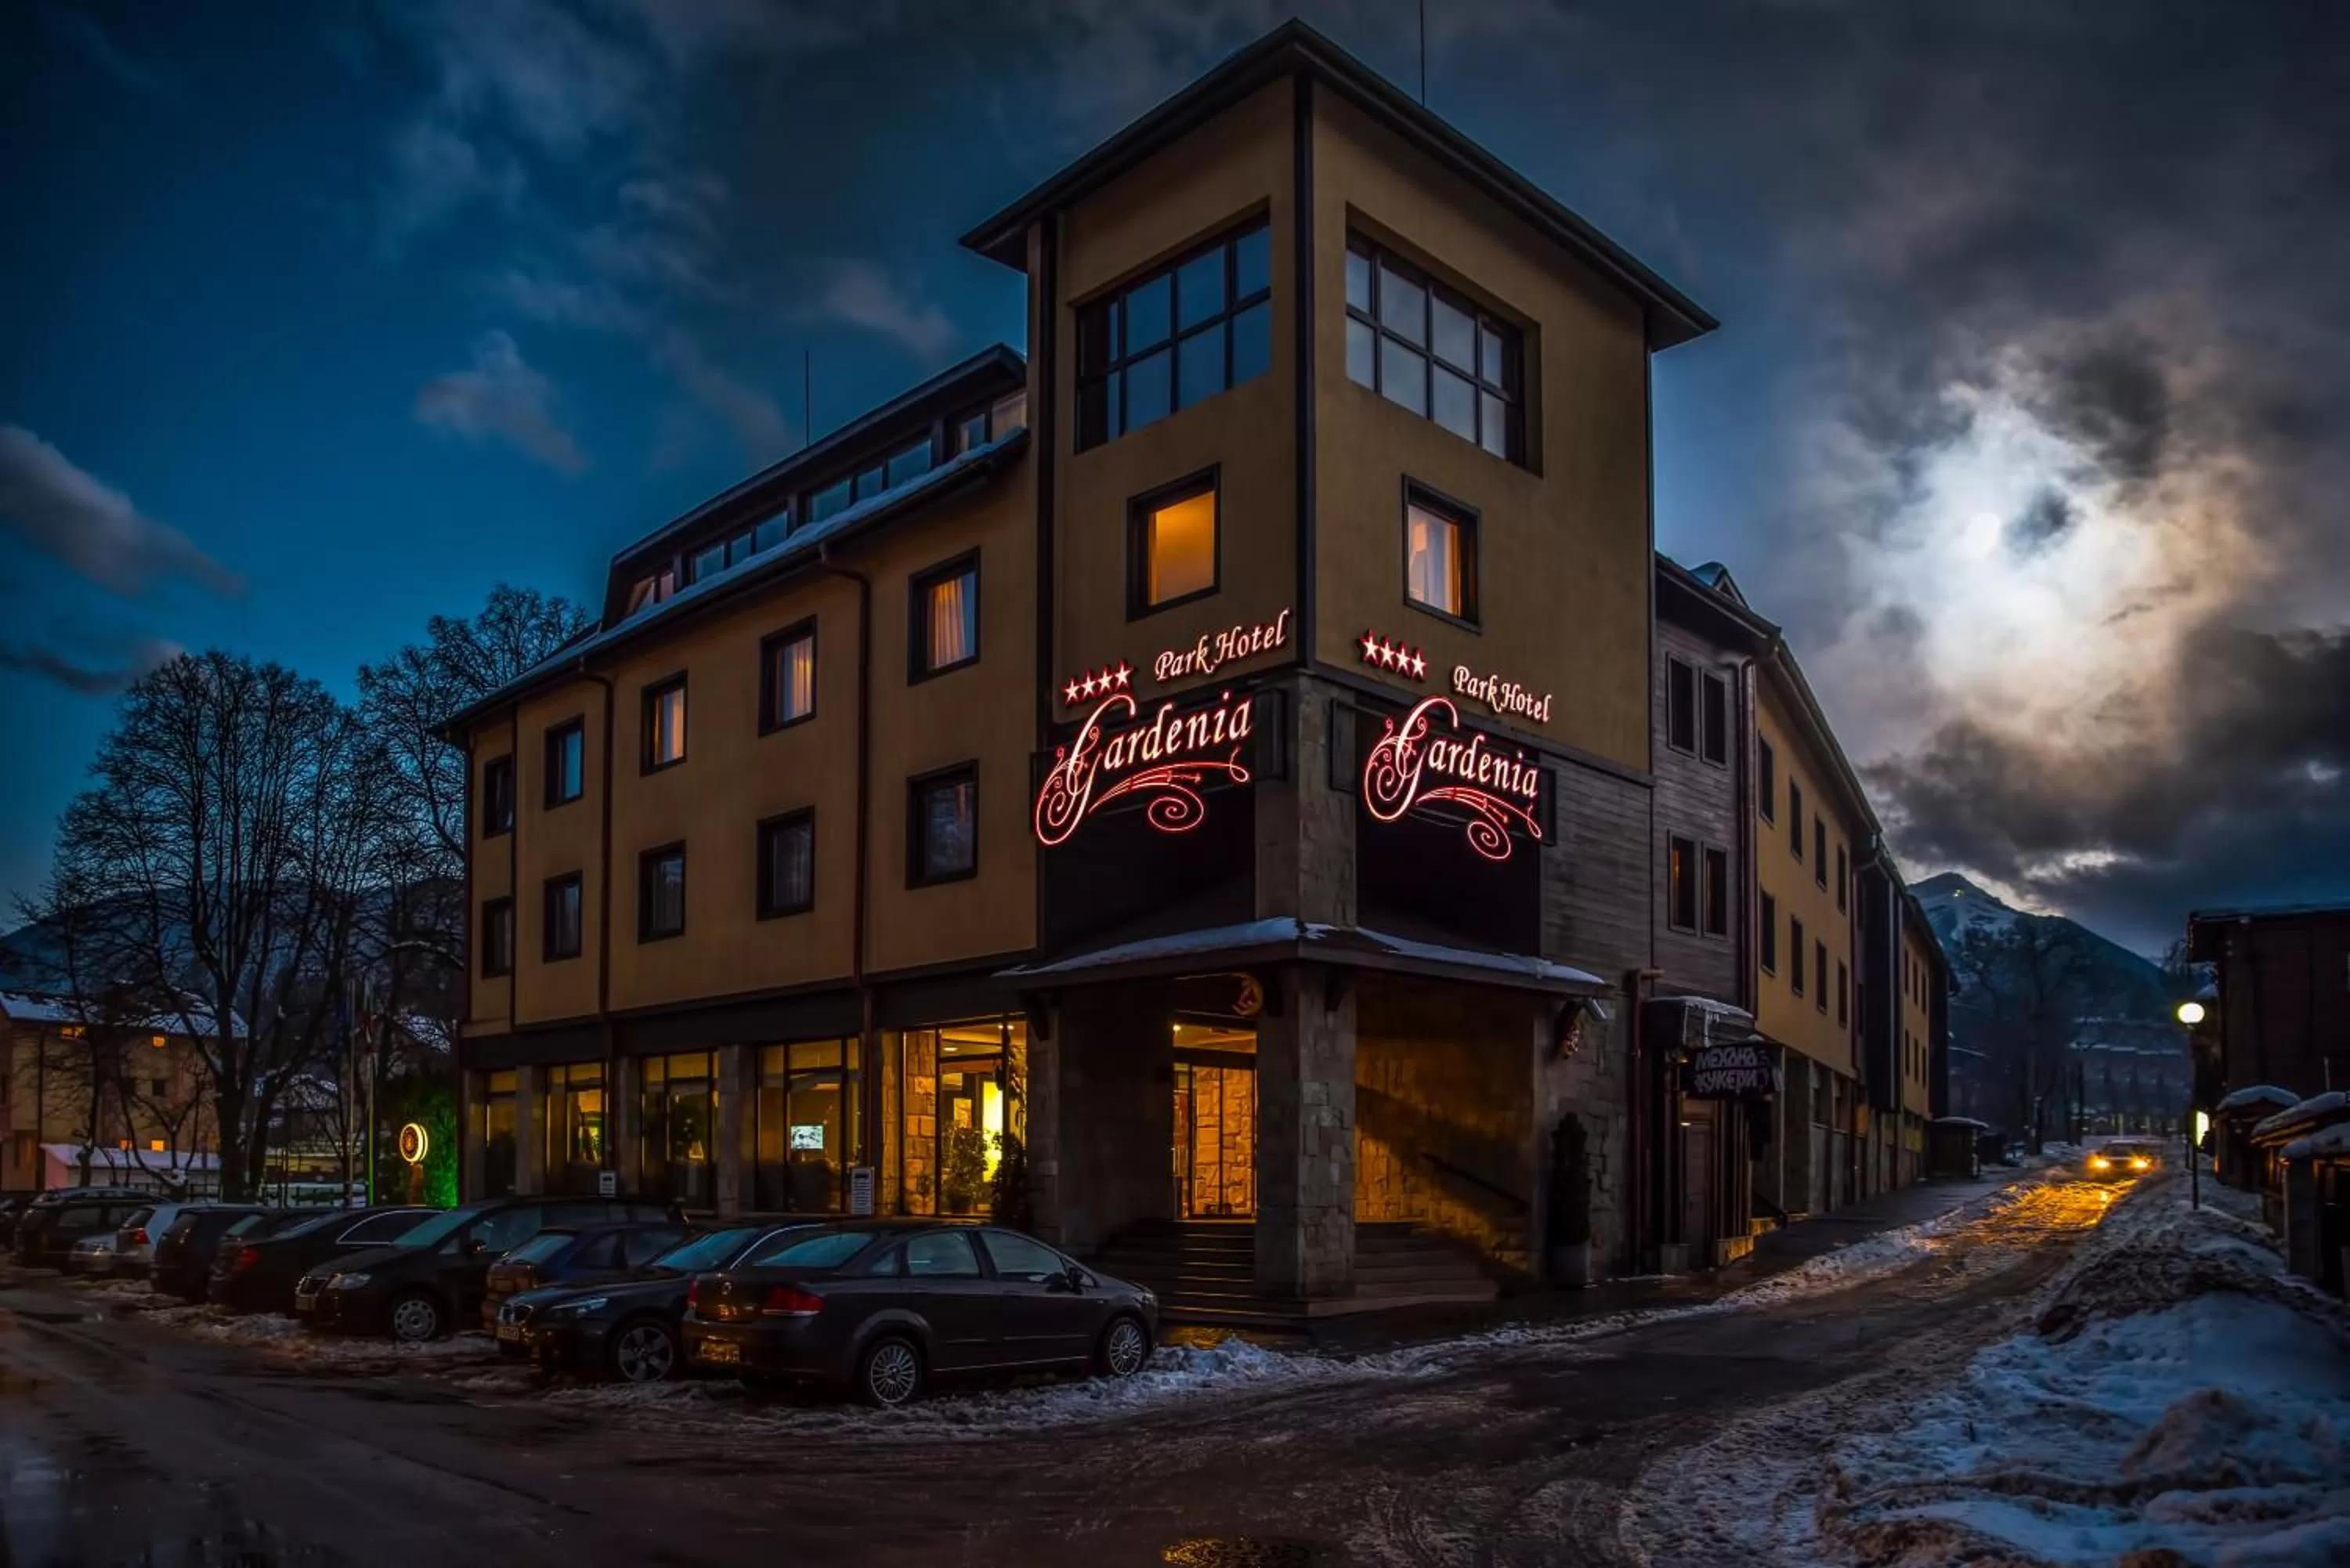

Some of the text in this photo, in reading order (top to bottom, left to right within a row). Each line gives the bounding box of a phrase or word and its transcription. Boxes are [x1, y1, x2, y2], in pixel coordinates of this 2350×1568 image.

[1155, 607, 1290, 682] Park Hotel
[1453, 665, 1551, 724] Park Hotel
[1036, 690, 1252, 845] Gardenia
[1364, 696, 1540, 821] Gardenia
